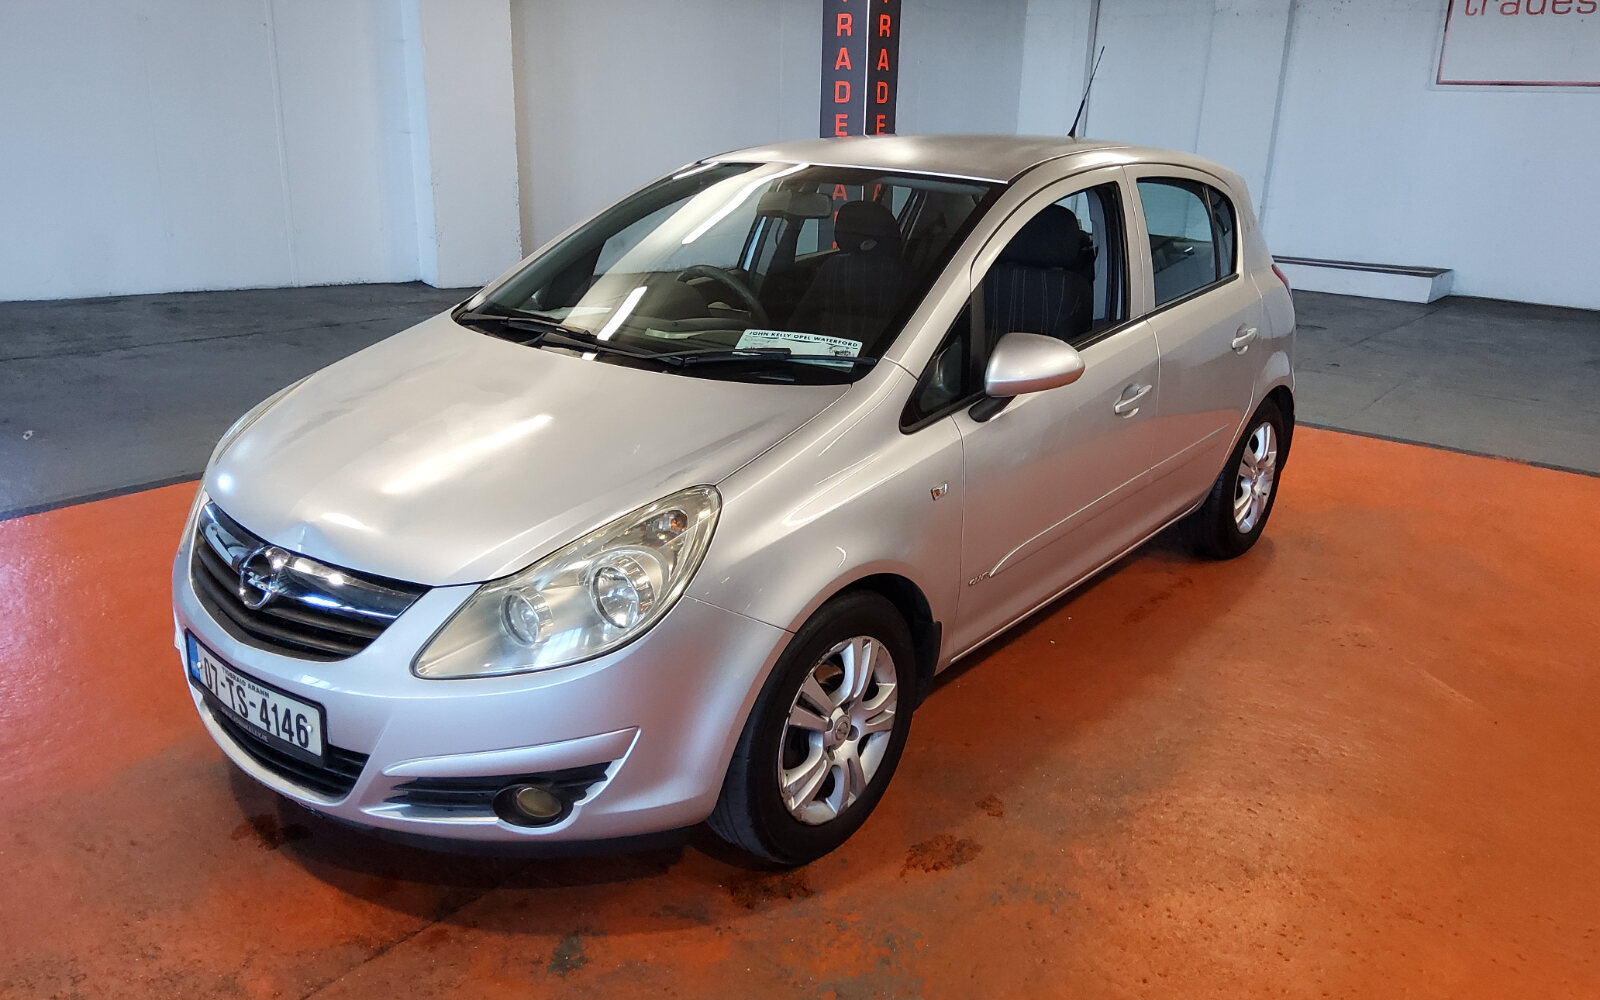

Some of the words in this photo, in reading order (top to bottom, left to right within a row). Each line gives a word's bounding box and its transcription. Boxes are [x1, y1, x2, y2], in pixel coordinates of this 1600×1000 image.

[834, 0, 853, 136] RADE
[876, 0, 892, 135] RADE
[813, 336, 858, 347] WATERFORD
[204, 657, 309, 748] 07-TS-4146
